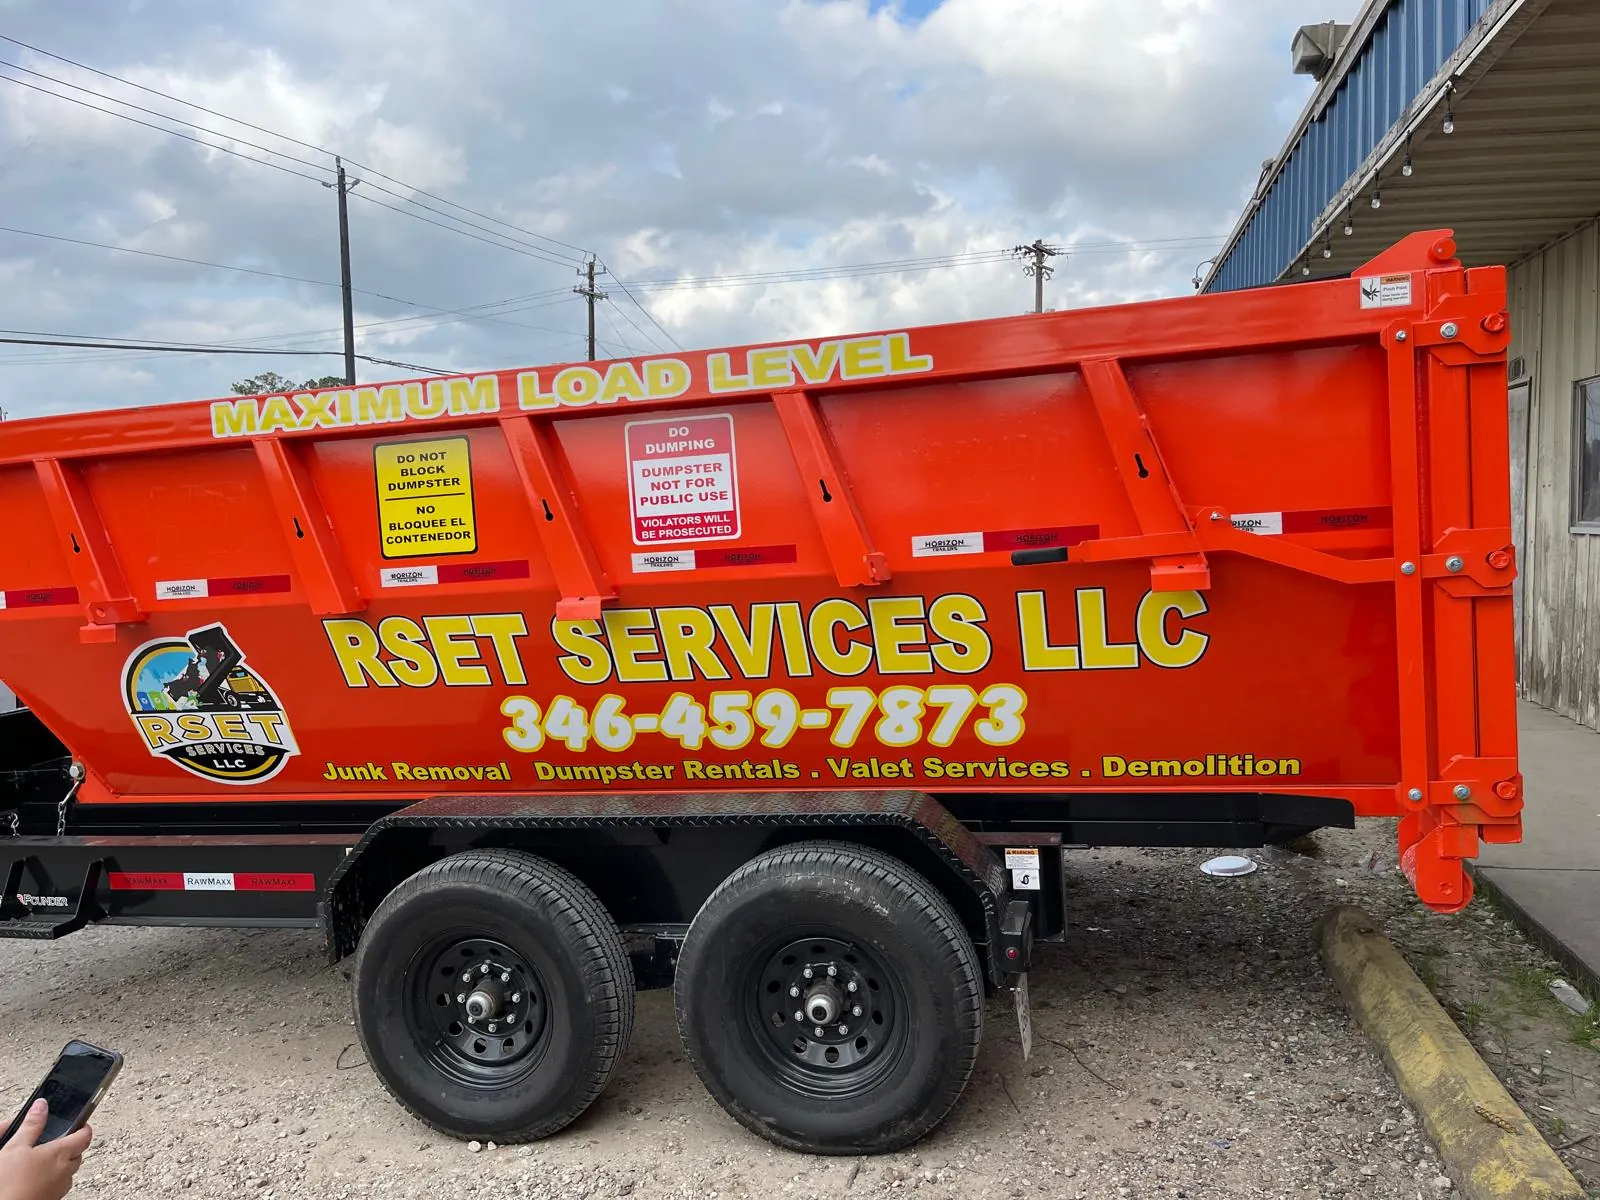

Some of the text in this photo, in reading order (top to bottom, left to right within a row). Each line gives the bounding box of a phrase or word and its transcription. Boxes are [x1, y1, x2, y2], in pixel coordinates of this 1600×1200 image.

[210, 332, 933, 438] MAXIMUM LOAD LEVEL
[668, 427, 689, 437] DO
[645, 439, 715, 454] DUMPING
[397, 452, 447, 463] DO NOT
[400, 465, 445, 476] BLOCK
[642, 463, 722, 477] DUMPSTER
[388, 478, 460, 491] DUMPSTER
[650, 478, 715, 491] NOT FOR
[640, 491, 728, 506] PUBLIC USE
[416, 505, 435, 514] NO
[389, 518, 466, 531] BLOQUEE EL
[641, 514, 730, 528] VIOLATORS WILL
[1231, 519, 1262, 527] RIZON
[386, 531, 471, 544] CONTENEDOR
[641, 525, 732, 539] BE PROSECUTED
[1016, 533, 1058, 542] HORIZON
[925, 539, 964, 547] HORIZON
[391, 571, 423, 579] HORIZON
[167, 585, 195, 593] HORIZON
[322, 586, 1210, 688] RSET SERVICES LLC
[500, 683, 1028, 752] 346-459-7873
[136, 712, 283, 749] RSET
[185, 743, 265, 757] SERVICES
[213, 759, 246, 768] LLC
[322, 761, 388, 783] Junk
[390, 761, 511, 782] Removal
[534, 760, 674, 785] Dumpster
[684, 758, 800, 781] Rentals
[826, 756, 914, 779] Valet
[923, 756, 1070, 778] Services
[1101, 754, 1302, 778] Demolition
